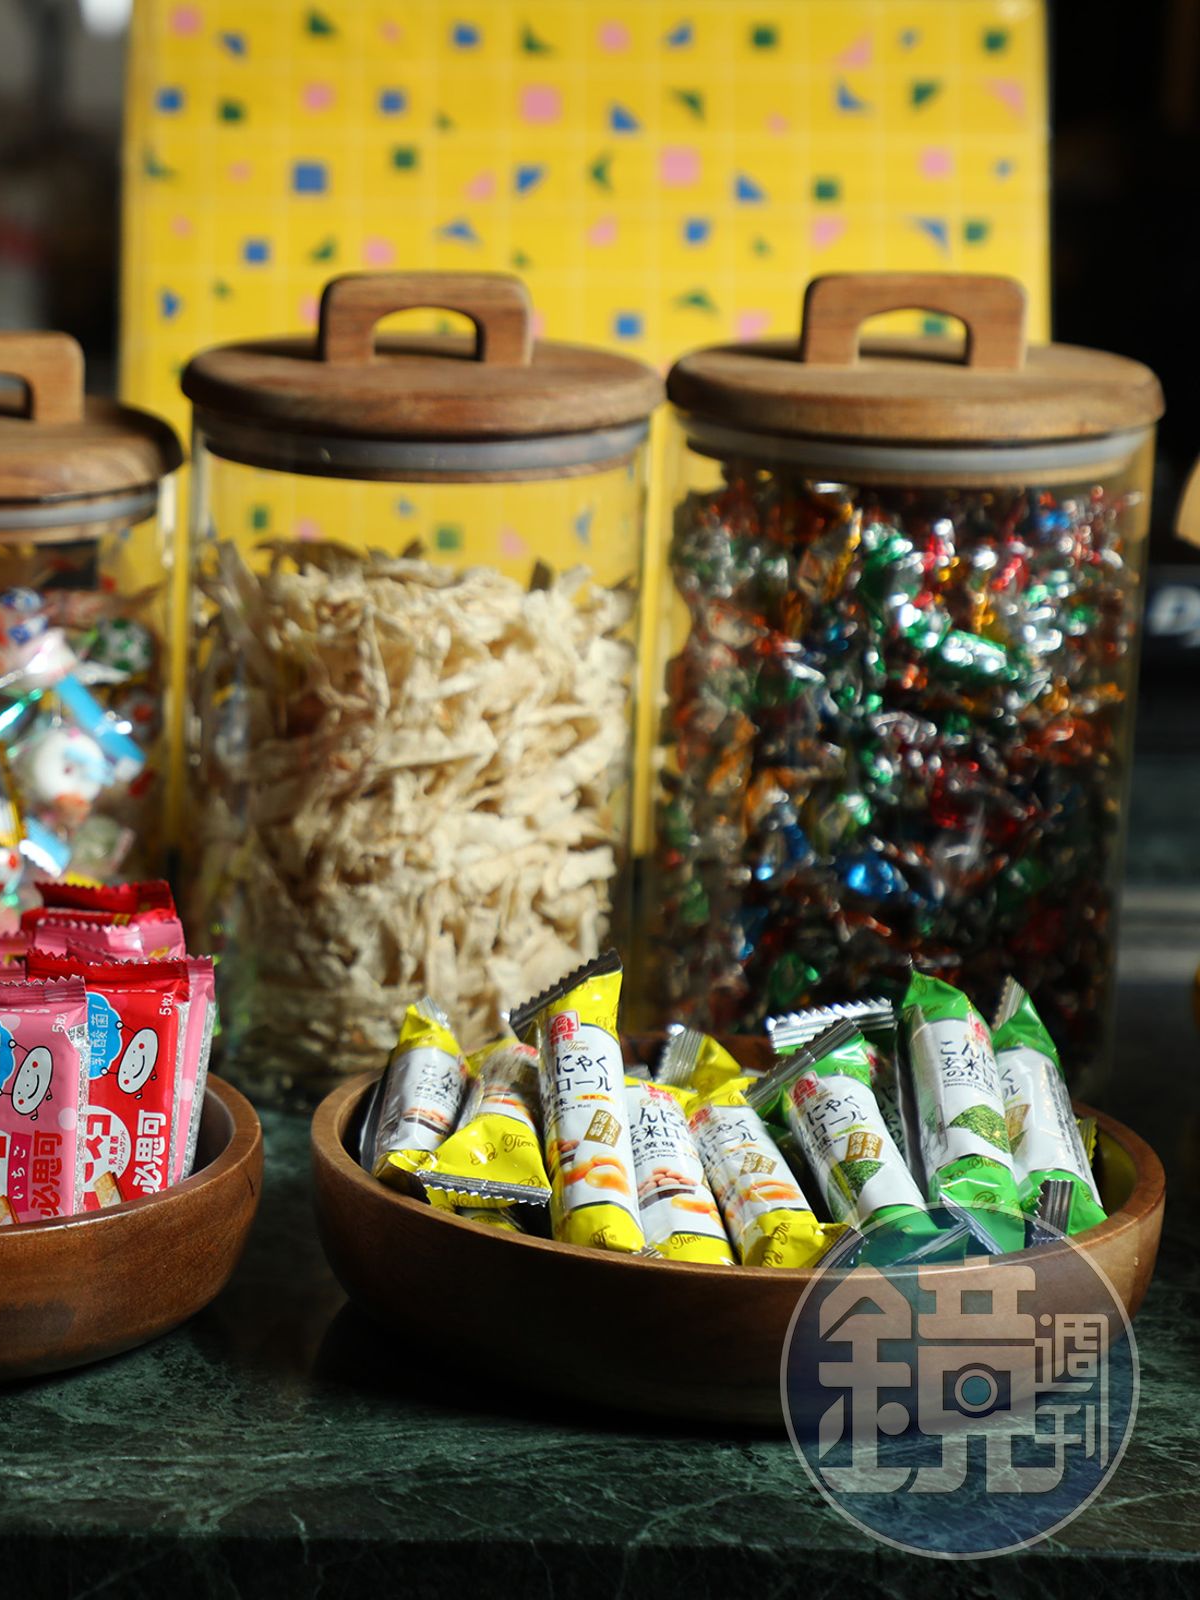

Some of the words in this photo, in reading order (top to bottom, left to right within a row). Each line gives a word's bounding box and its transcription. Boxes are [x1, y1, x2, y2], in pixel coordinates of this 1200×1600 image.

[88, 1004, 110, 1067] 乳酸菌!
[11, 1144, 27, 1201] いちご
[30, 1129, 64, 1217] 必思可
[131, 1107, 167, 1194] 必思可
